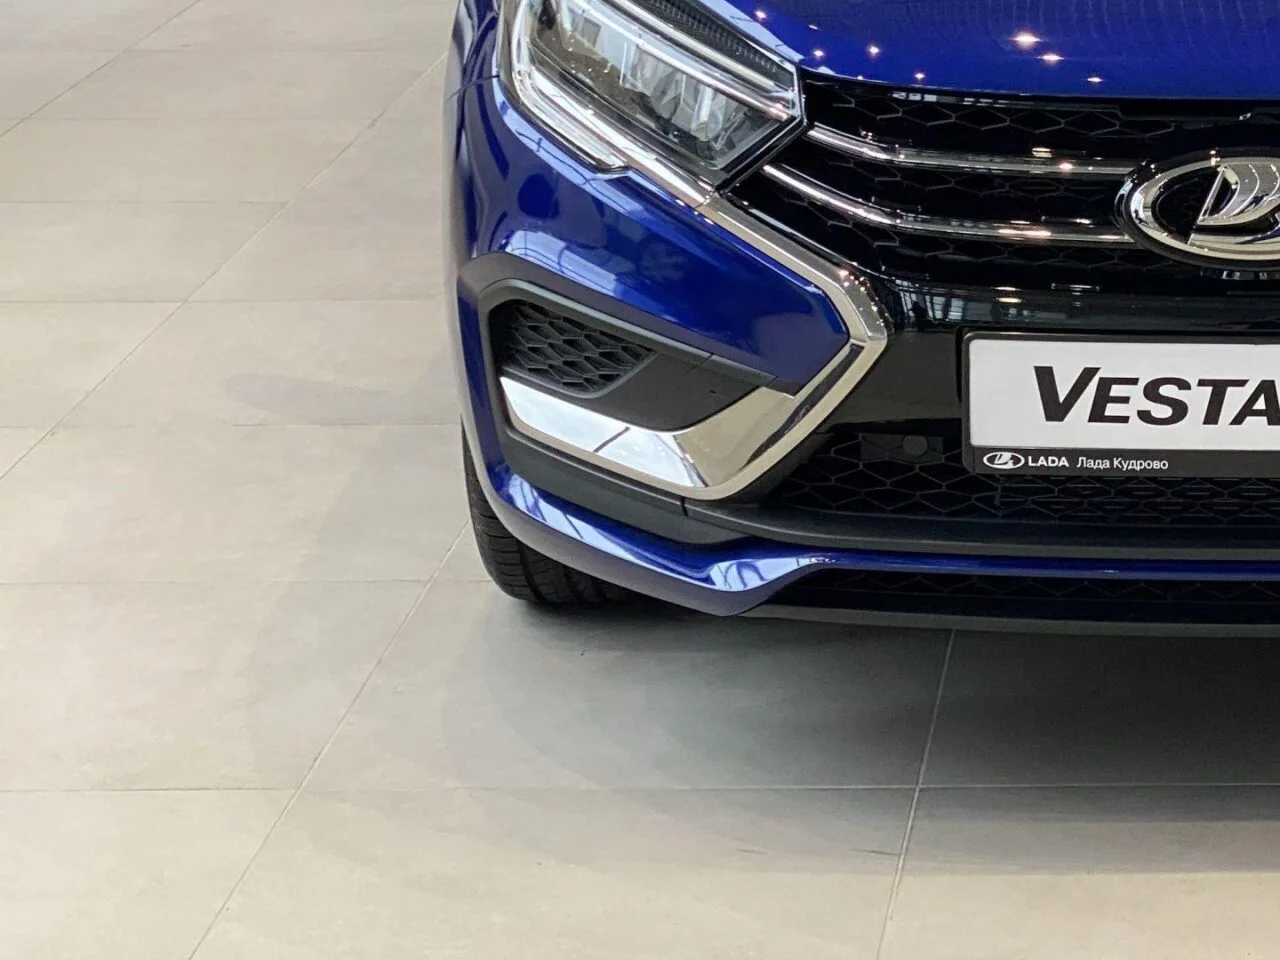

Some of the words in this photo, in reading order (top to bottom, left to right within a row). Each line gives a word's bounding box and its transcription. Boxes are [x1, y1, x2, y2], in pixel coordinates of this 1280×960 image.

[1027, 455, 1069, 468] LADA
[1076, 456, 1111, 470] Лада
[1113, 457, 1169, 471] Кудрово
